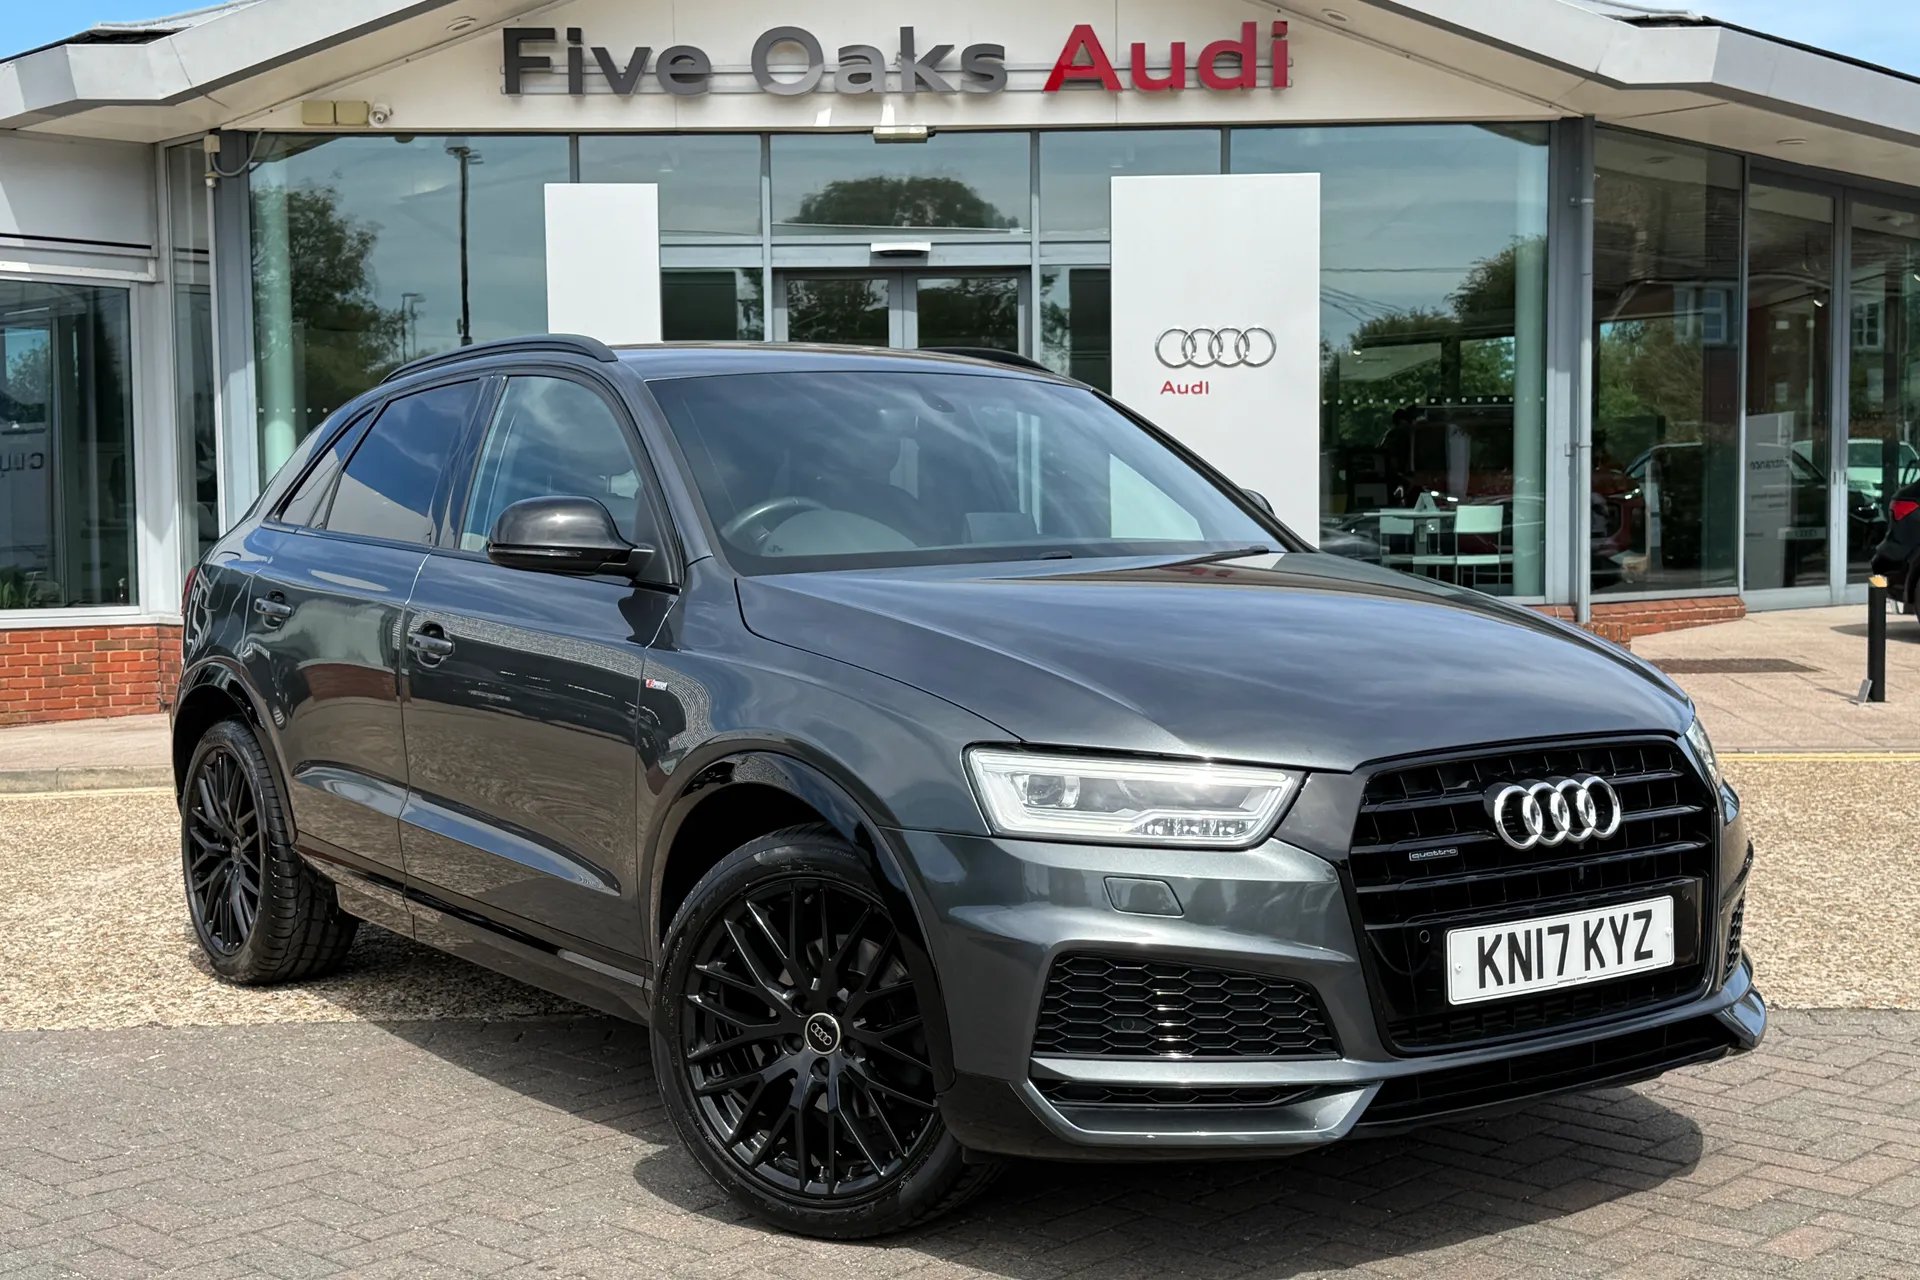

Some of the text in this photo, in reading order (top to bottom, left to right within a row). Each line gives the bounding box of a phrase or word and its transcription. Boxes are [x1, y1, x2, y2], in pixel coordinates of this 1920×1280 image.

[503, 21, 1289, 96] Five Oaks Audi
[1160, 380, 1209, 395] Audi
[1411, 848, 1457, 860] quattro
[1478, 909, 1654, 989] KN17 KYZ
